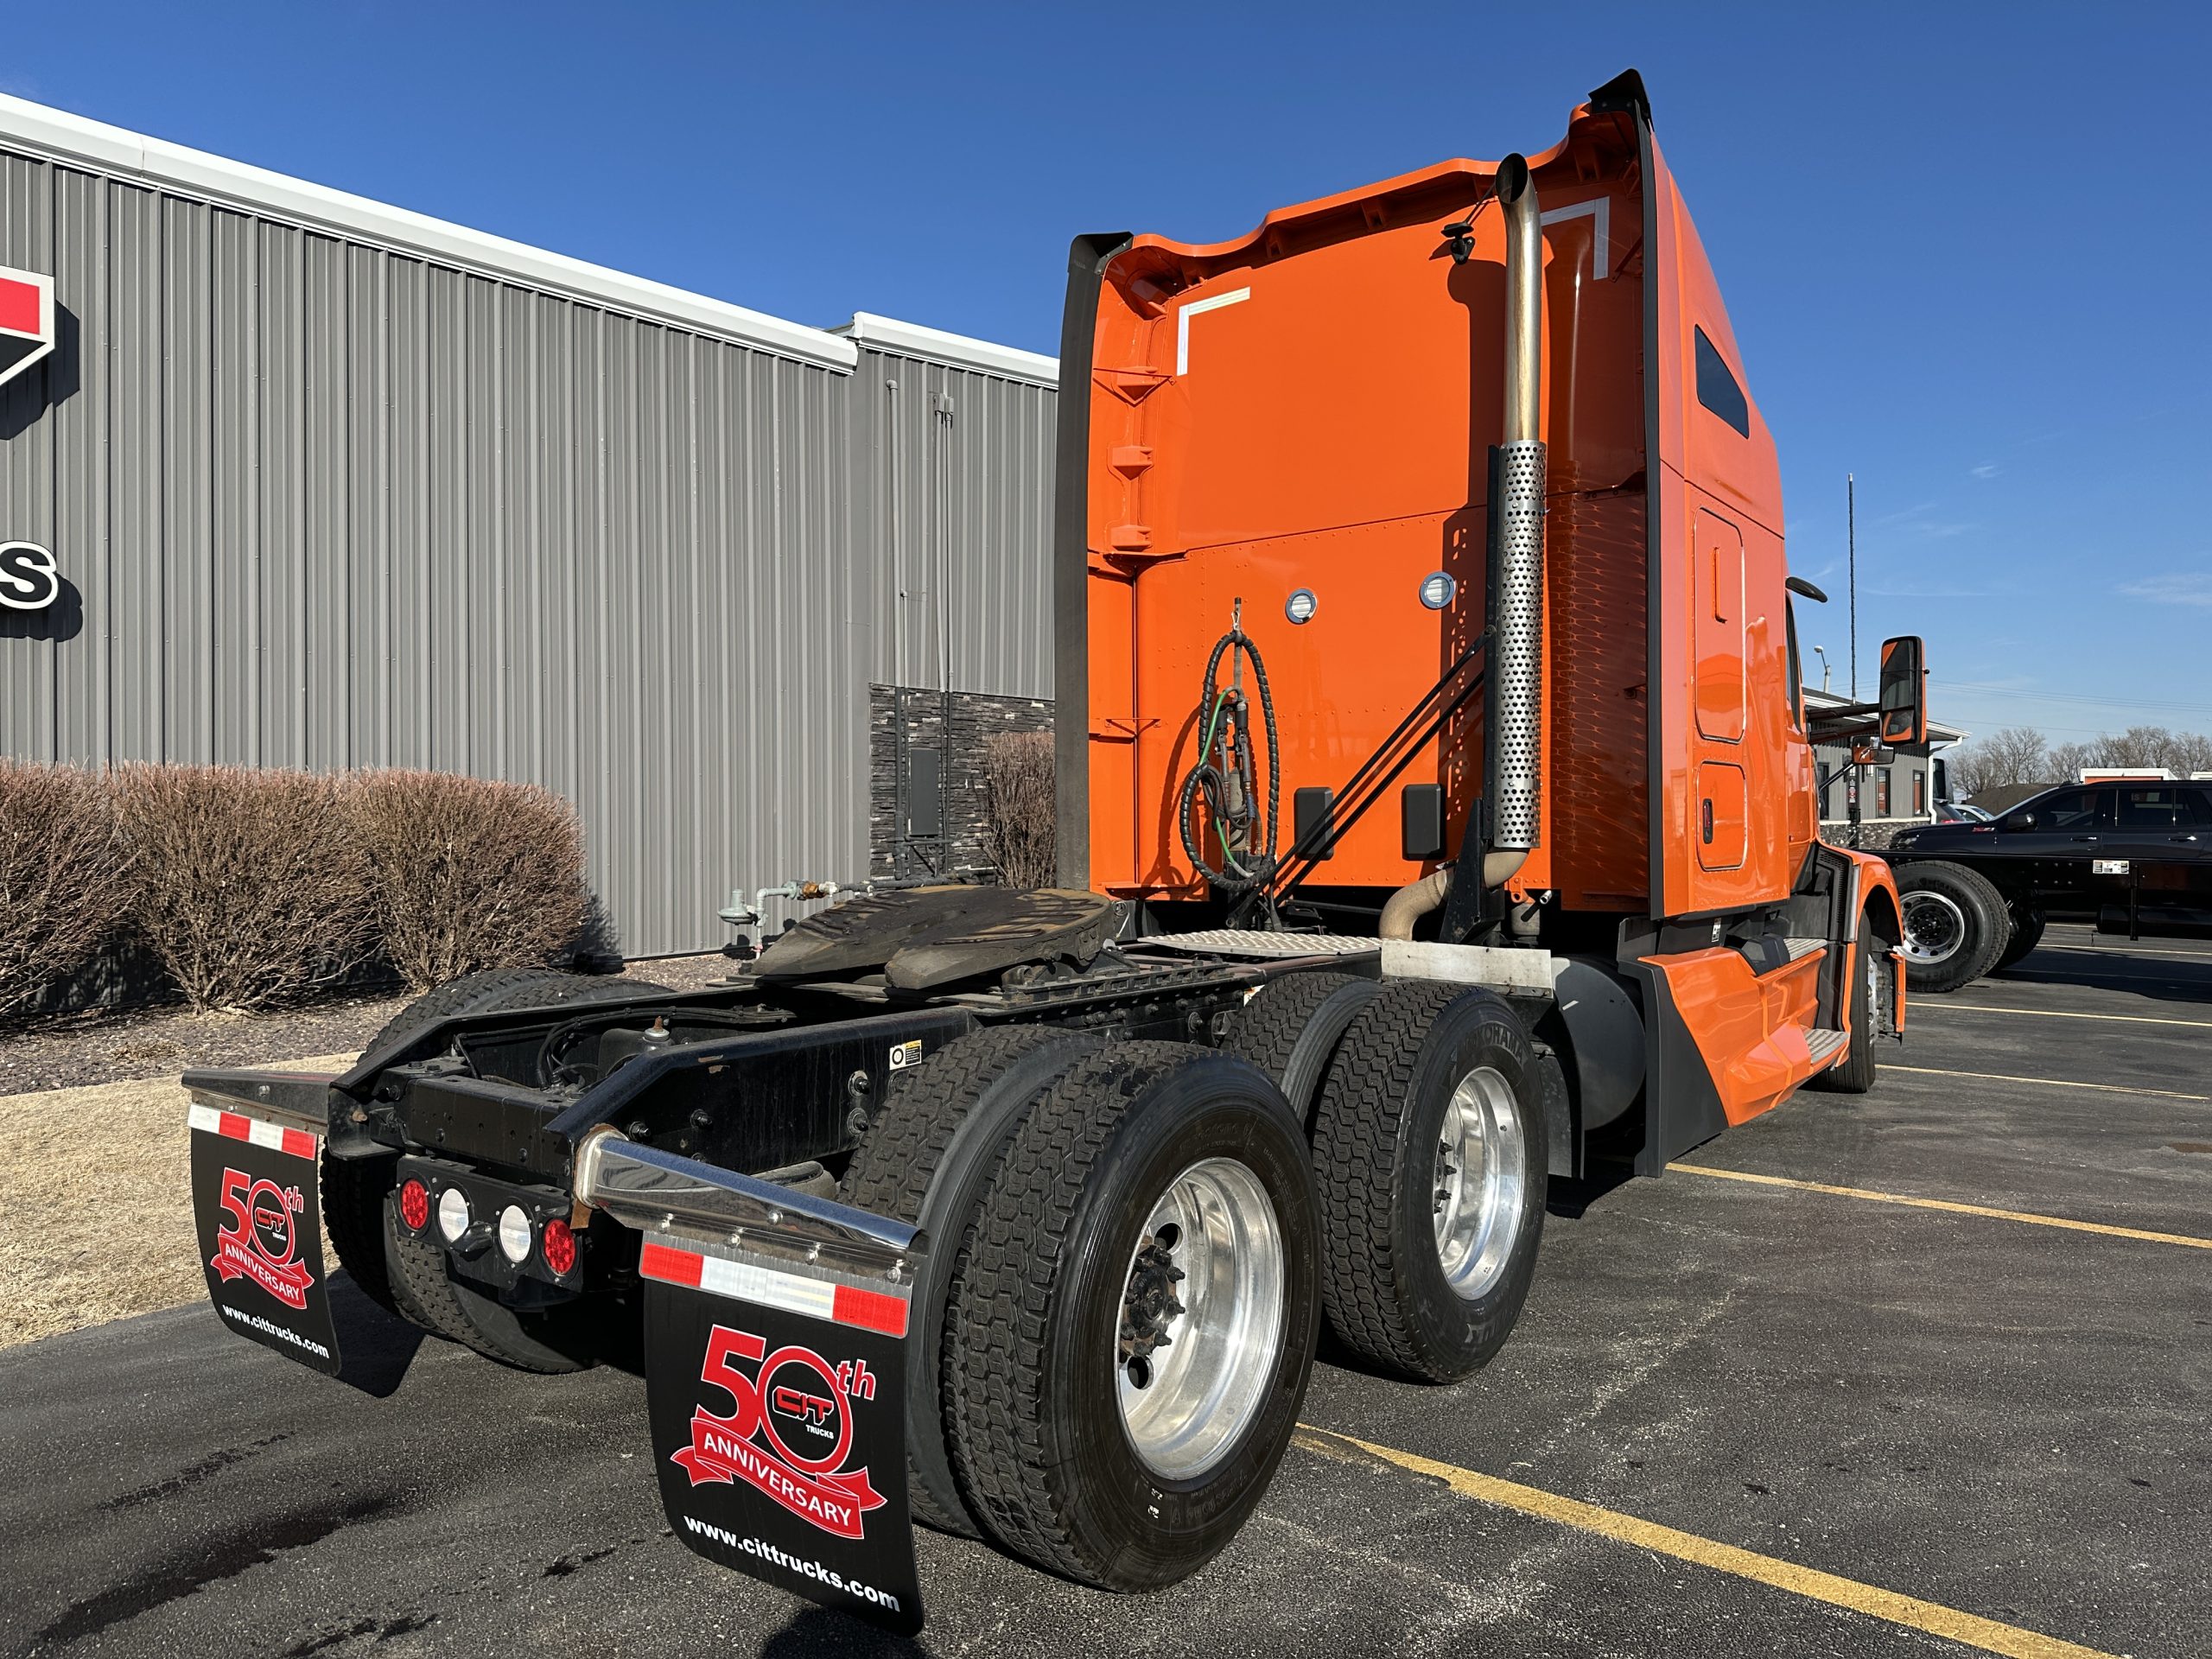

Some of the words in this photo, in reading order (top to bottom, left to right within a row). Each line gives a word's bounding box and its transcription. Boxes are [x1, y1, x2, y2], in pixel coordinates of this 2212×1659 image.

[255, 1207, 285, 1232] CIT
[225, 1243, 300, 1300] ANNIVERSARY
[222, 1303, 330, 1358] www.cittrucks.com
[772, 1385, 834, 1426] CIT
[805, 1424, 834, 1440] TRUCKS
[703, 1432, 852, 1527] ANNIVERSARY
[683, 1515, 900, 1613] www.cittrucks.com
